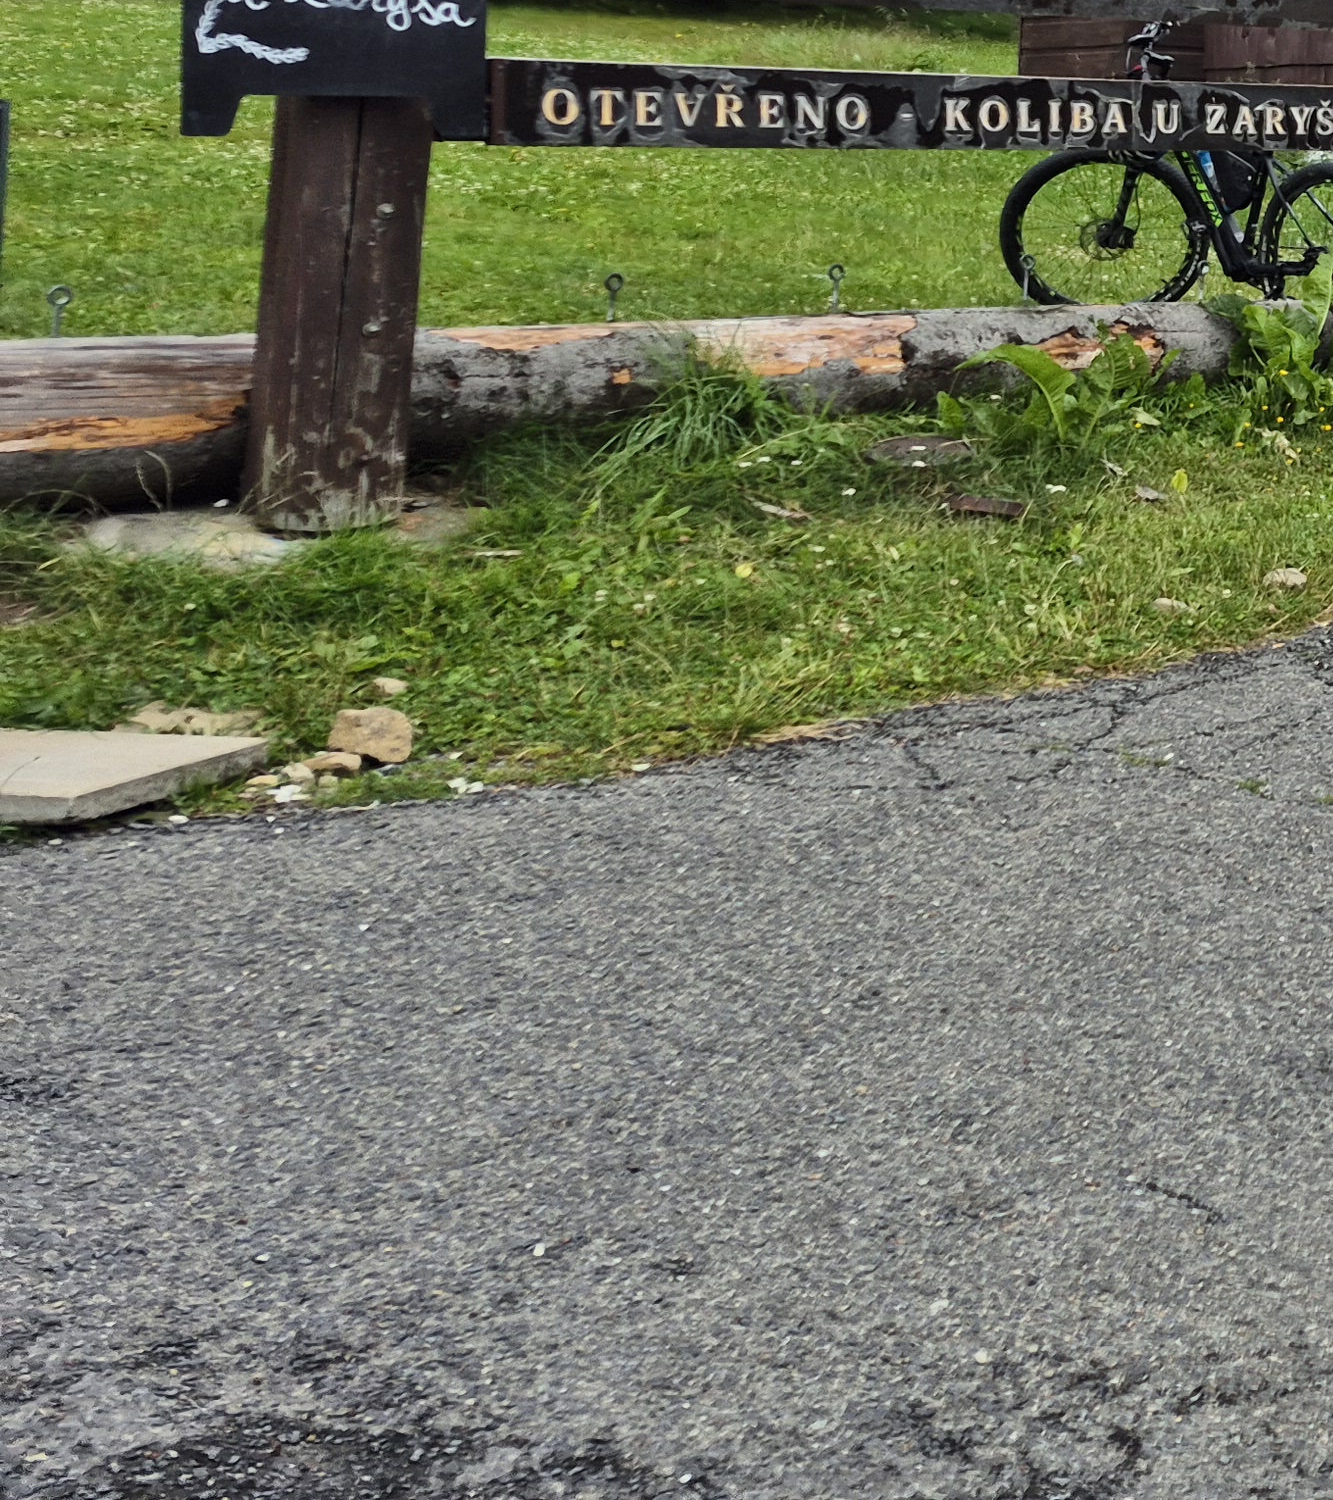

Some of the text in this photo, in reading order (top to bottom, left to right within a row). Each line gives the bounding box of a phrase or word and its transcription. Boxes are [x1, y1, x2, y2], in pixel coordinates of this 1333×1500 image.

[541, 84, 868, 130] OTEVŘENO
[944, 98, 1128, 135] KOLIBA
[1155, 100, 1182, 134] U
